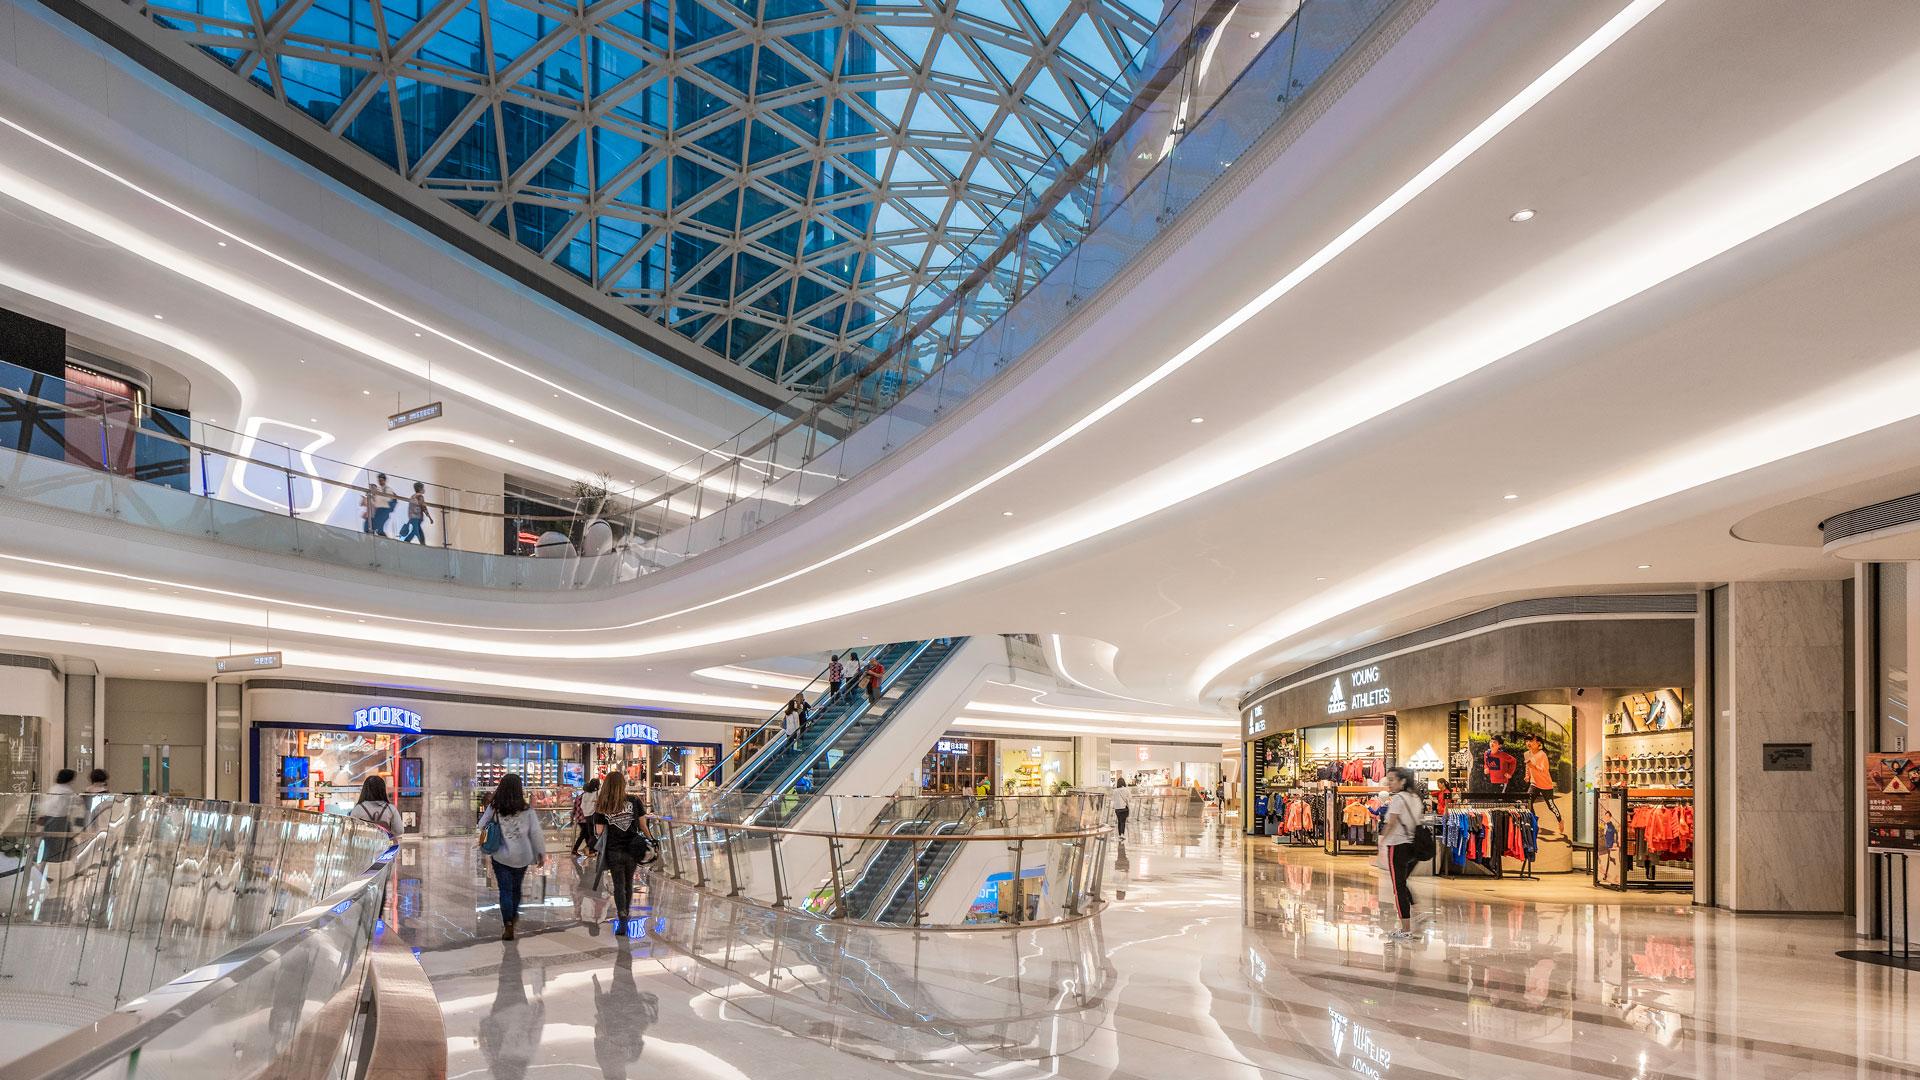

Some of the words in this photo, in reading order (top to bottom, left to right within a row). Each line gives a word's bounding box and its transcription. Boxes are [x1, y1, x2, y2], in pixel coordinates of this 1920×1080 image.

[1351, 666, 1379, 686] YOUNG
[1352, 688, 1390, 709] ATHLETES
[355, 706, 422, 733] ROOKIE
[615, 723, 660, 744] ROOKIE
